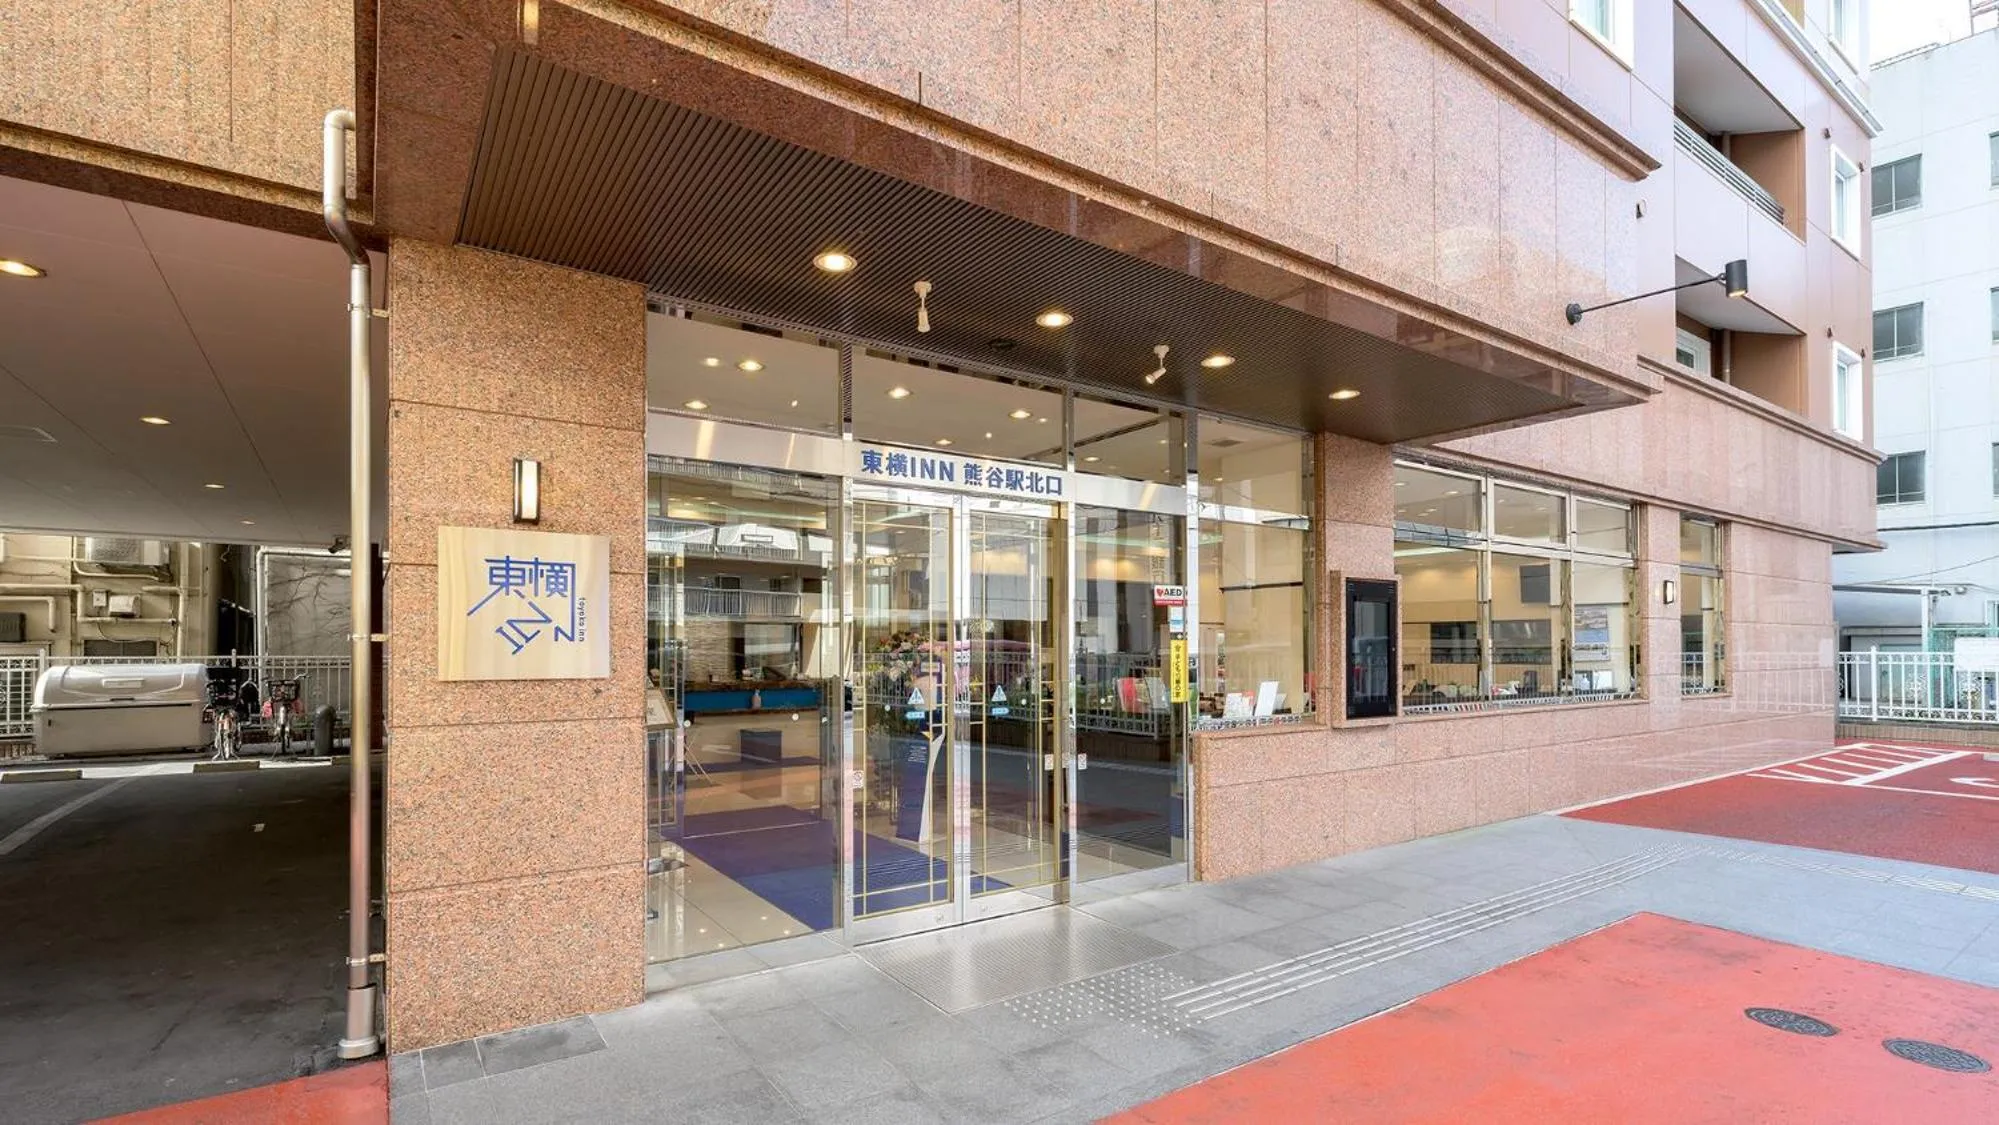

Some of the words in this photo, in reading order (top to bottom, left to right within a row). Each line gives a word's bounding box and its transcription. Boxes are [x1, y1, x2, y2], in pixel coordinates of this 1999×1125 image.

[861, 449, 955, 482] 東横INN
[963, 462, 1063, 496] 熊谷駅北口
[1164, 587, 1183, 597] AED
[577, 597, 586, 627] toyoko
[578, 628, 586, 642] inn
